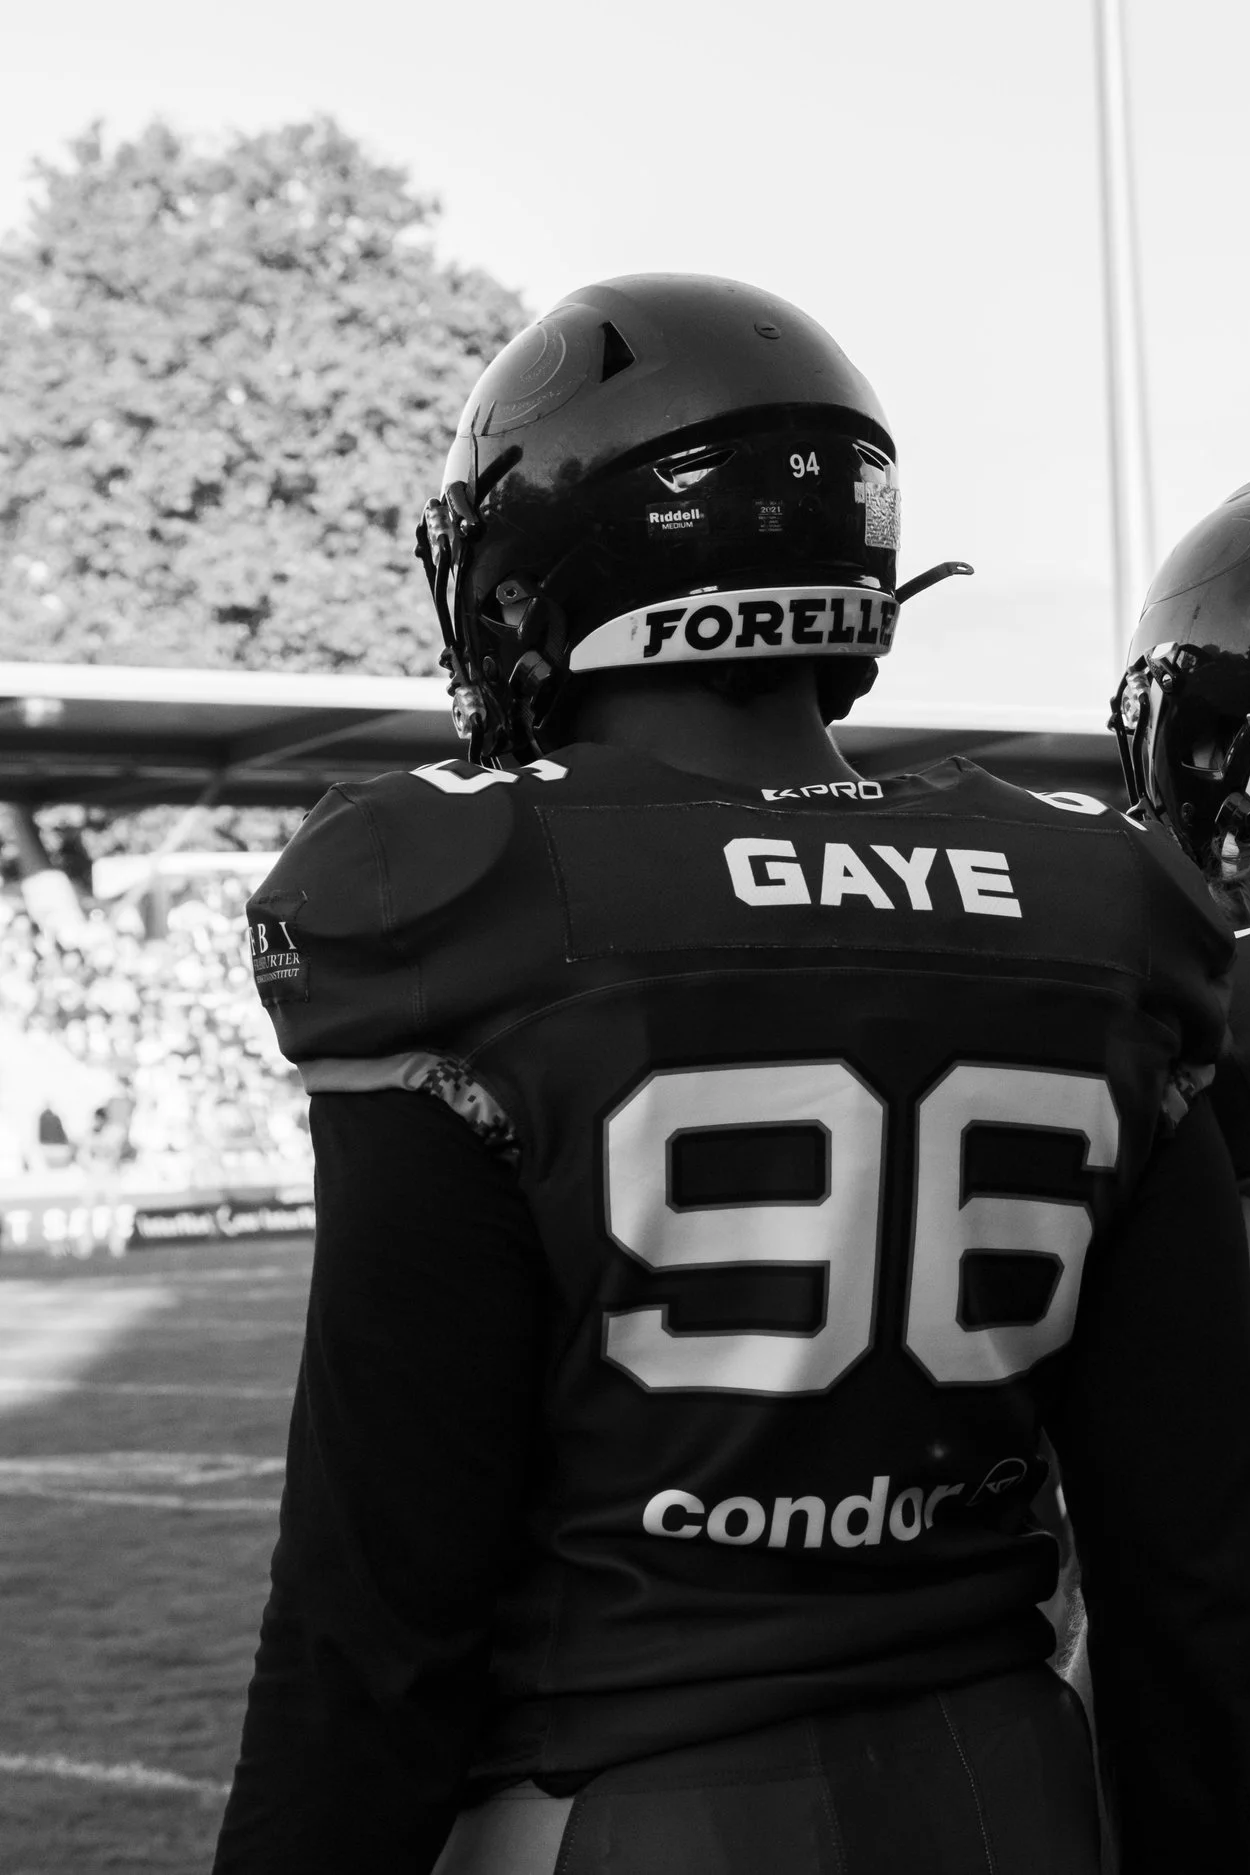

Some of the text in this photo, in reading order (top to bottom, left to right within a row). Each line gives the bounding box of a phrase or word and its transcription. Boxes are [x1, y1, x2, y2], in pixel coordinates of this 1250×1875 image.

[789, 451, 820, 479] 94
[649, 508, 700, 524] Riddell
[662, 521, 693, 530] MEDIUM
[723, 837, 1023, 918] GAYE
[602, 1057, 1122, 1397] 96
[641, 1474, 965, 1549] condor
